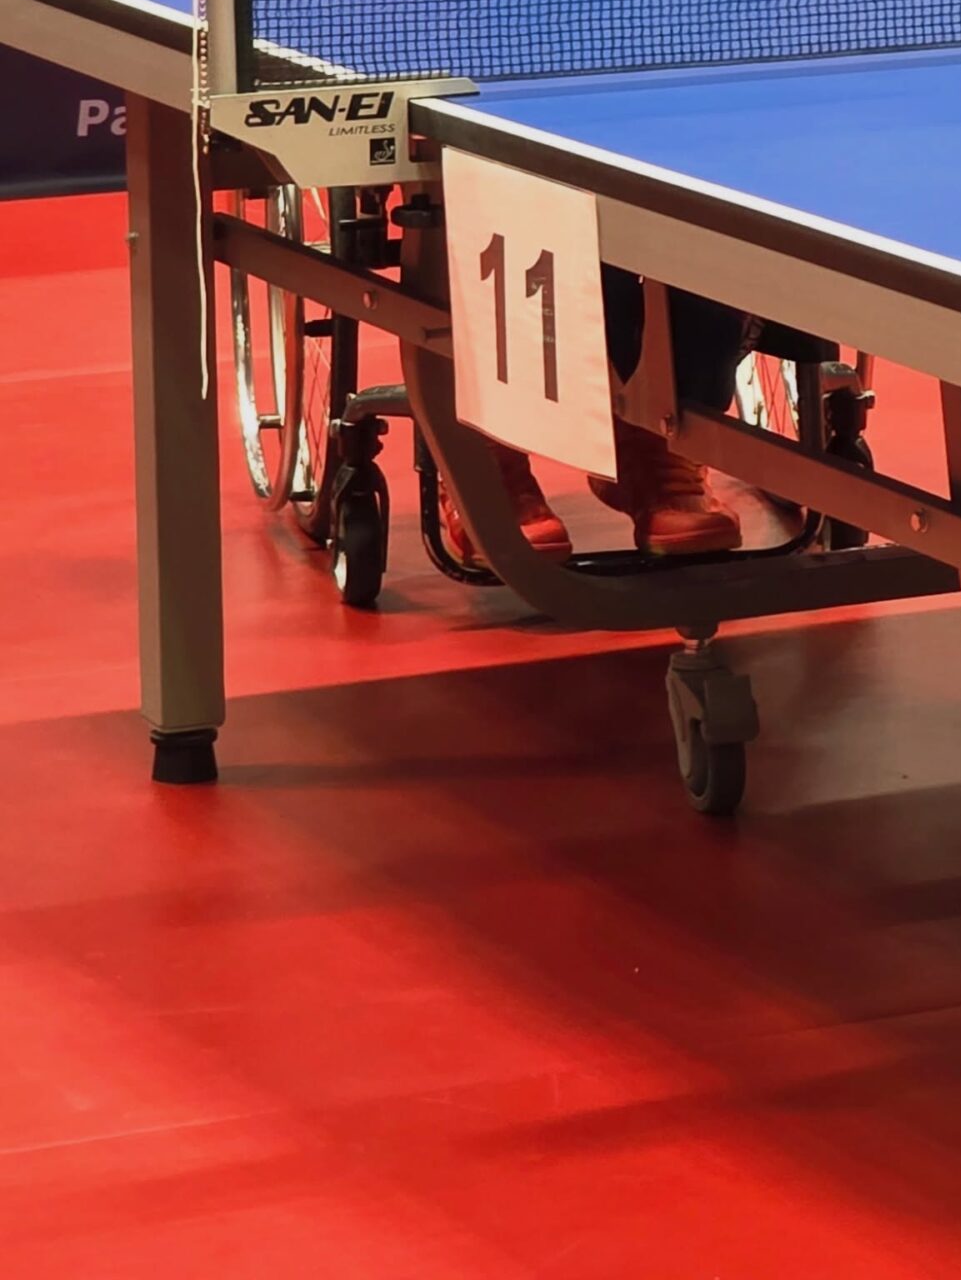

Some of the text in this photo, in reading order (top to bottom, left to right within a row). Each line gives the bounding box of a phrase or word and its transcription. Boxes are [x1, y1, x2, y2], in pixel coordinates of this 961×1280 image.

[244, 91, 394, 127] SAN-EI
[329, 123, 396, 137] LIMITLESS
[479, 232, 559, 404] 11
